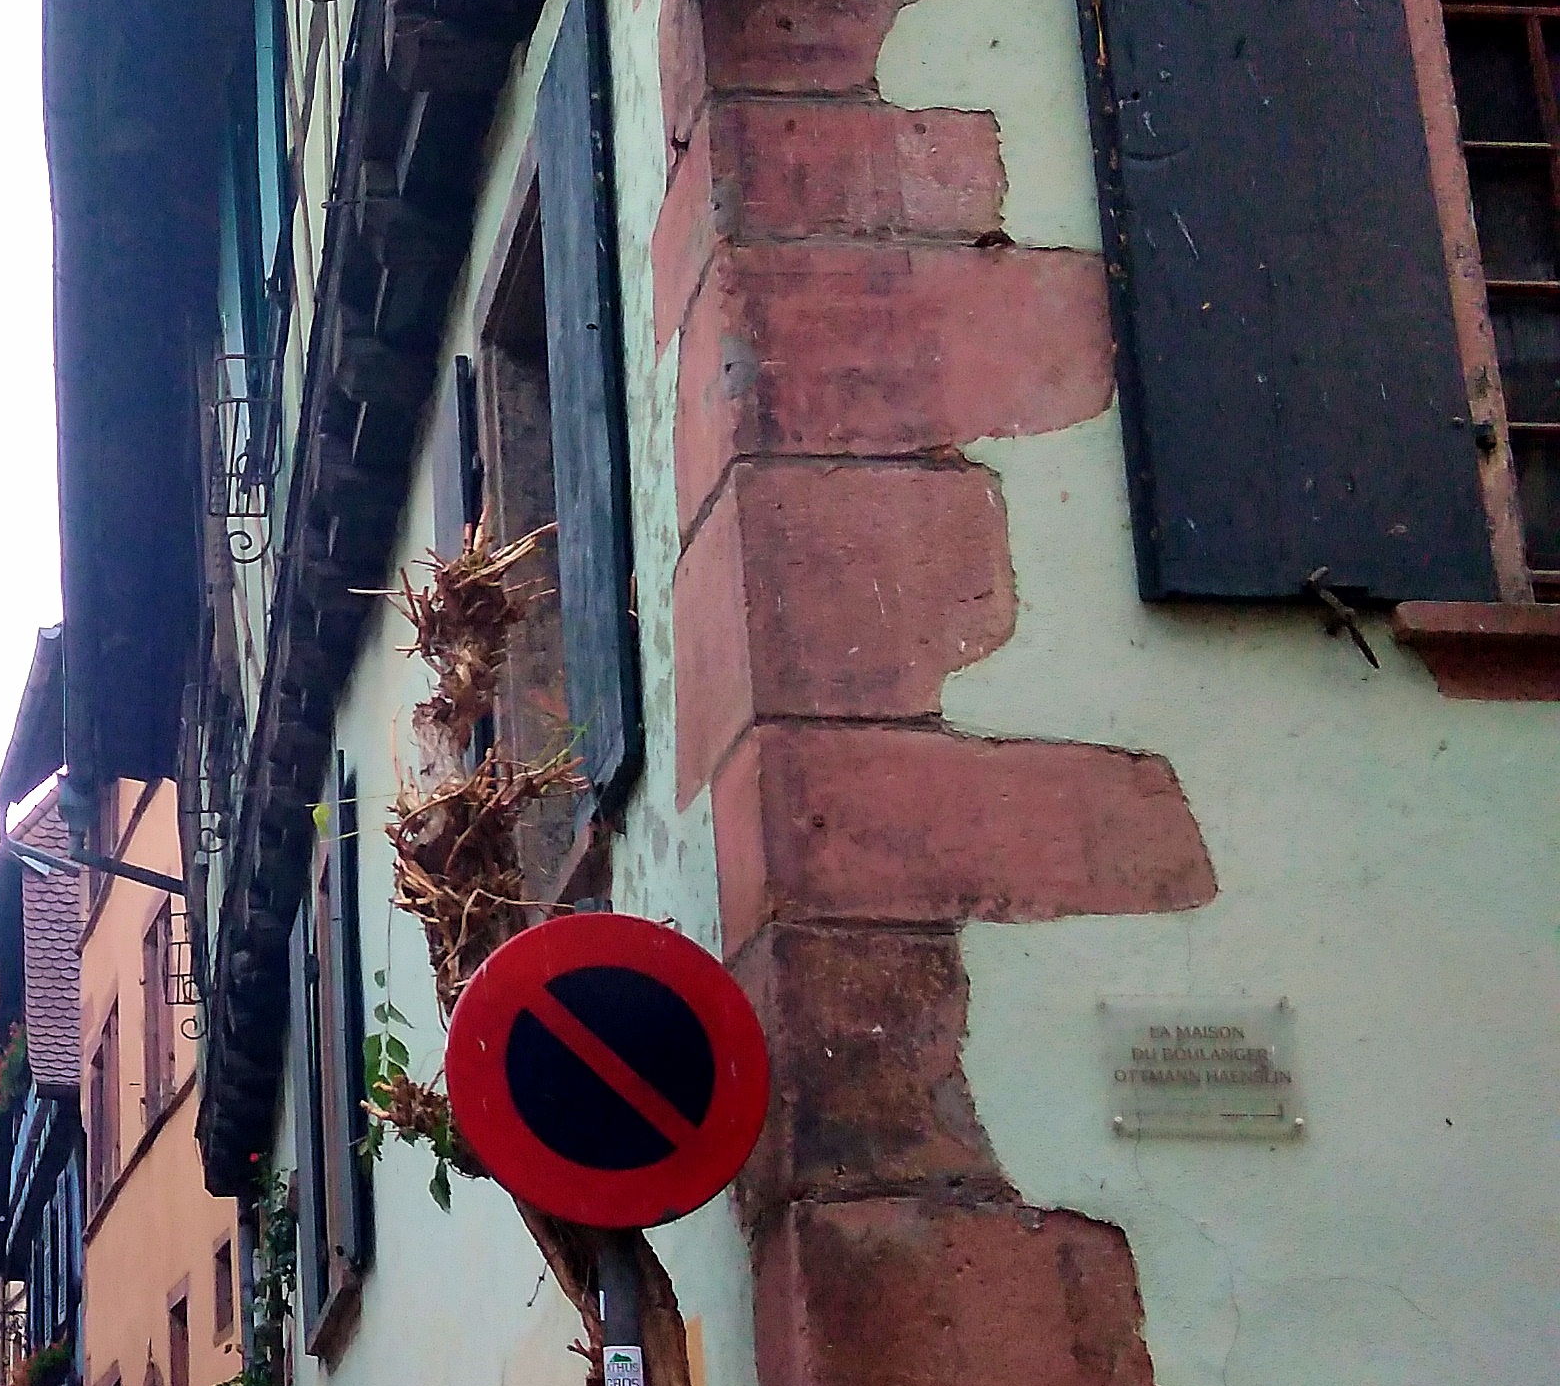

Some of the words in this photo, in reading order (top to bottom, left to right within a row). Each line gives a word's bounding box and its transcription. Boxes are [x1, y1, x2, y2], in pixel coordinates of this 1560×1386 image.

[1149, 1025, 1170, 1039] LA
[1176, 1025, 1245, 1040] MAISON
[1131, 1047, 1156, 1061] DU
[1162, 1047, 1269, 1062] BOULANGER
